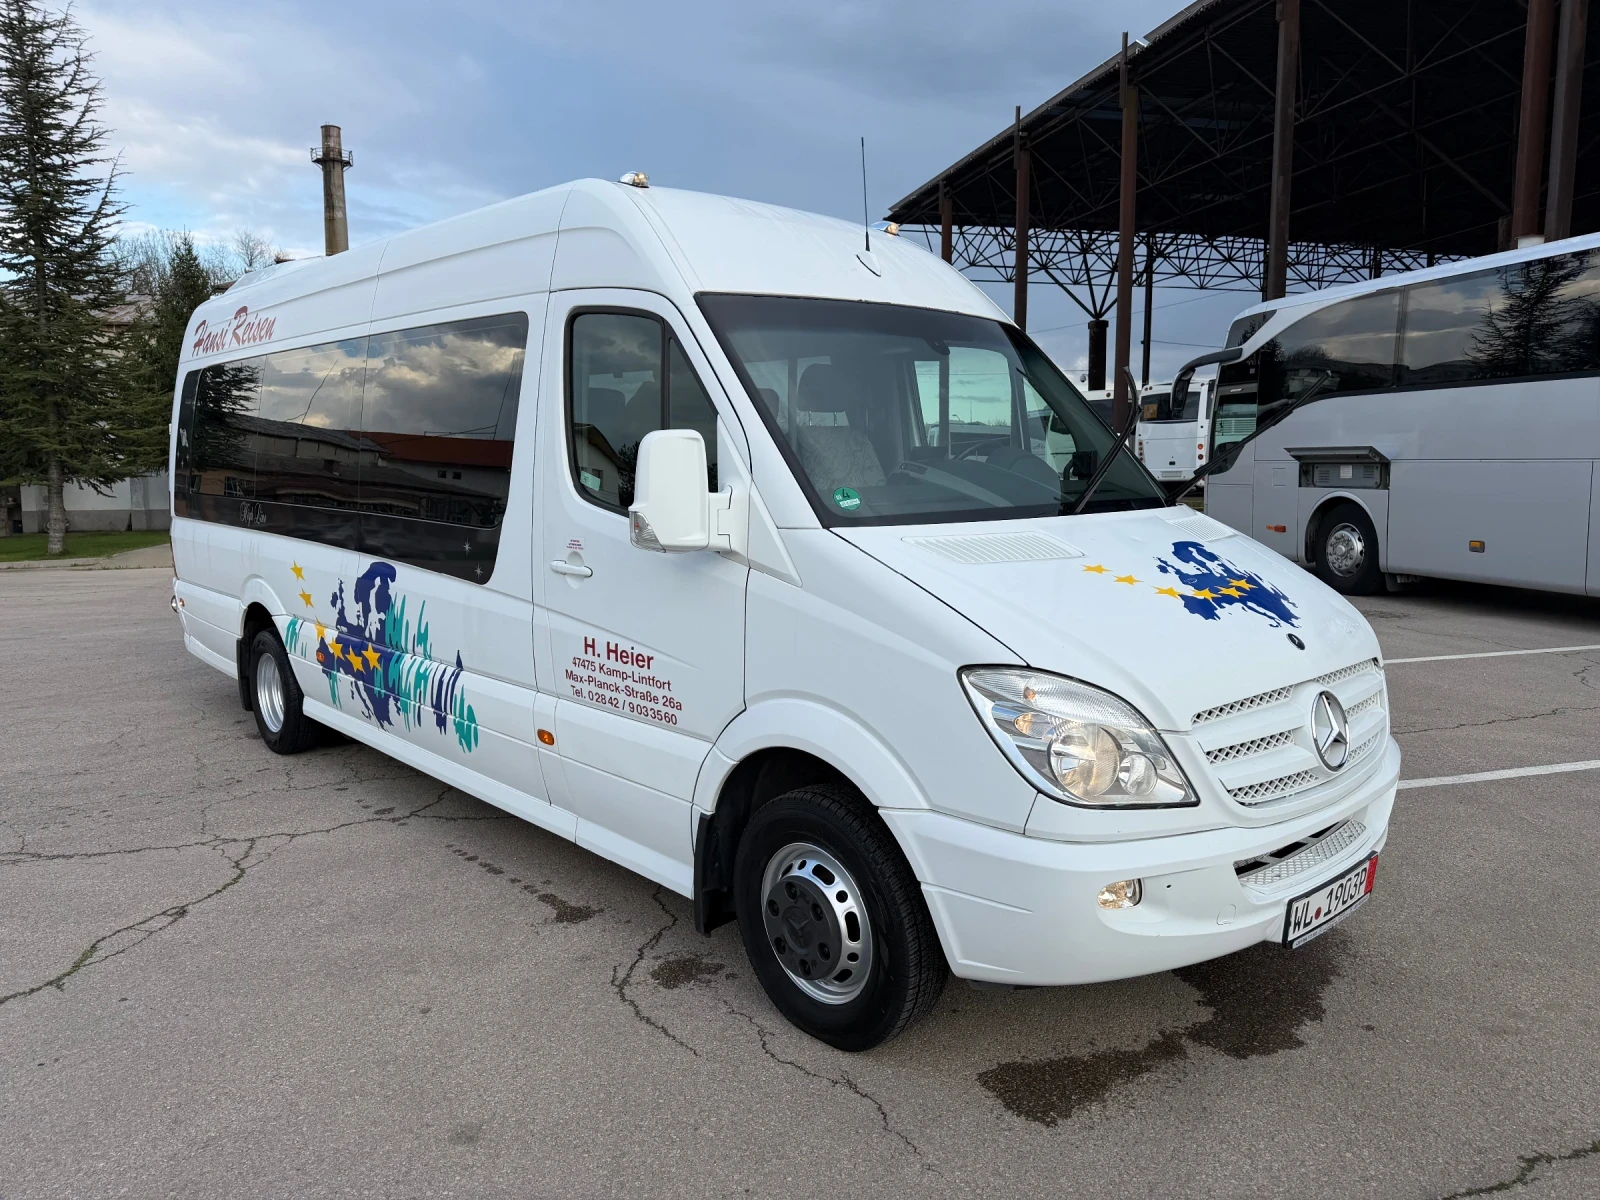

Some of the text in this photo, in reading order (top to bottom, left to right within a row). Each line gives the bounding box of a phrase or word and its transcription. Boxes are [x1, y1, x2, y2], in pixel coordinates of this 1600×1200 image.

[191, 306, 277, 357] Hansi Reisen
[842, 489, 851, 498] 4
[584, 636, 654, 670] H. Heier
[565, 669, 682, 711] Max-Planck-Straße 26a
[570, 684, 586, 699] Tel.
[572, 656, 672, 692] 47475 Kamp-Lintfort
[1292, 900, 1313, 934] WL
[1323, 867, 1367, 918] 1903P
